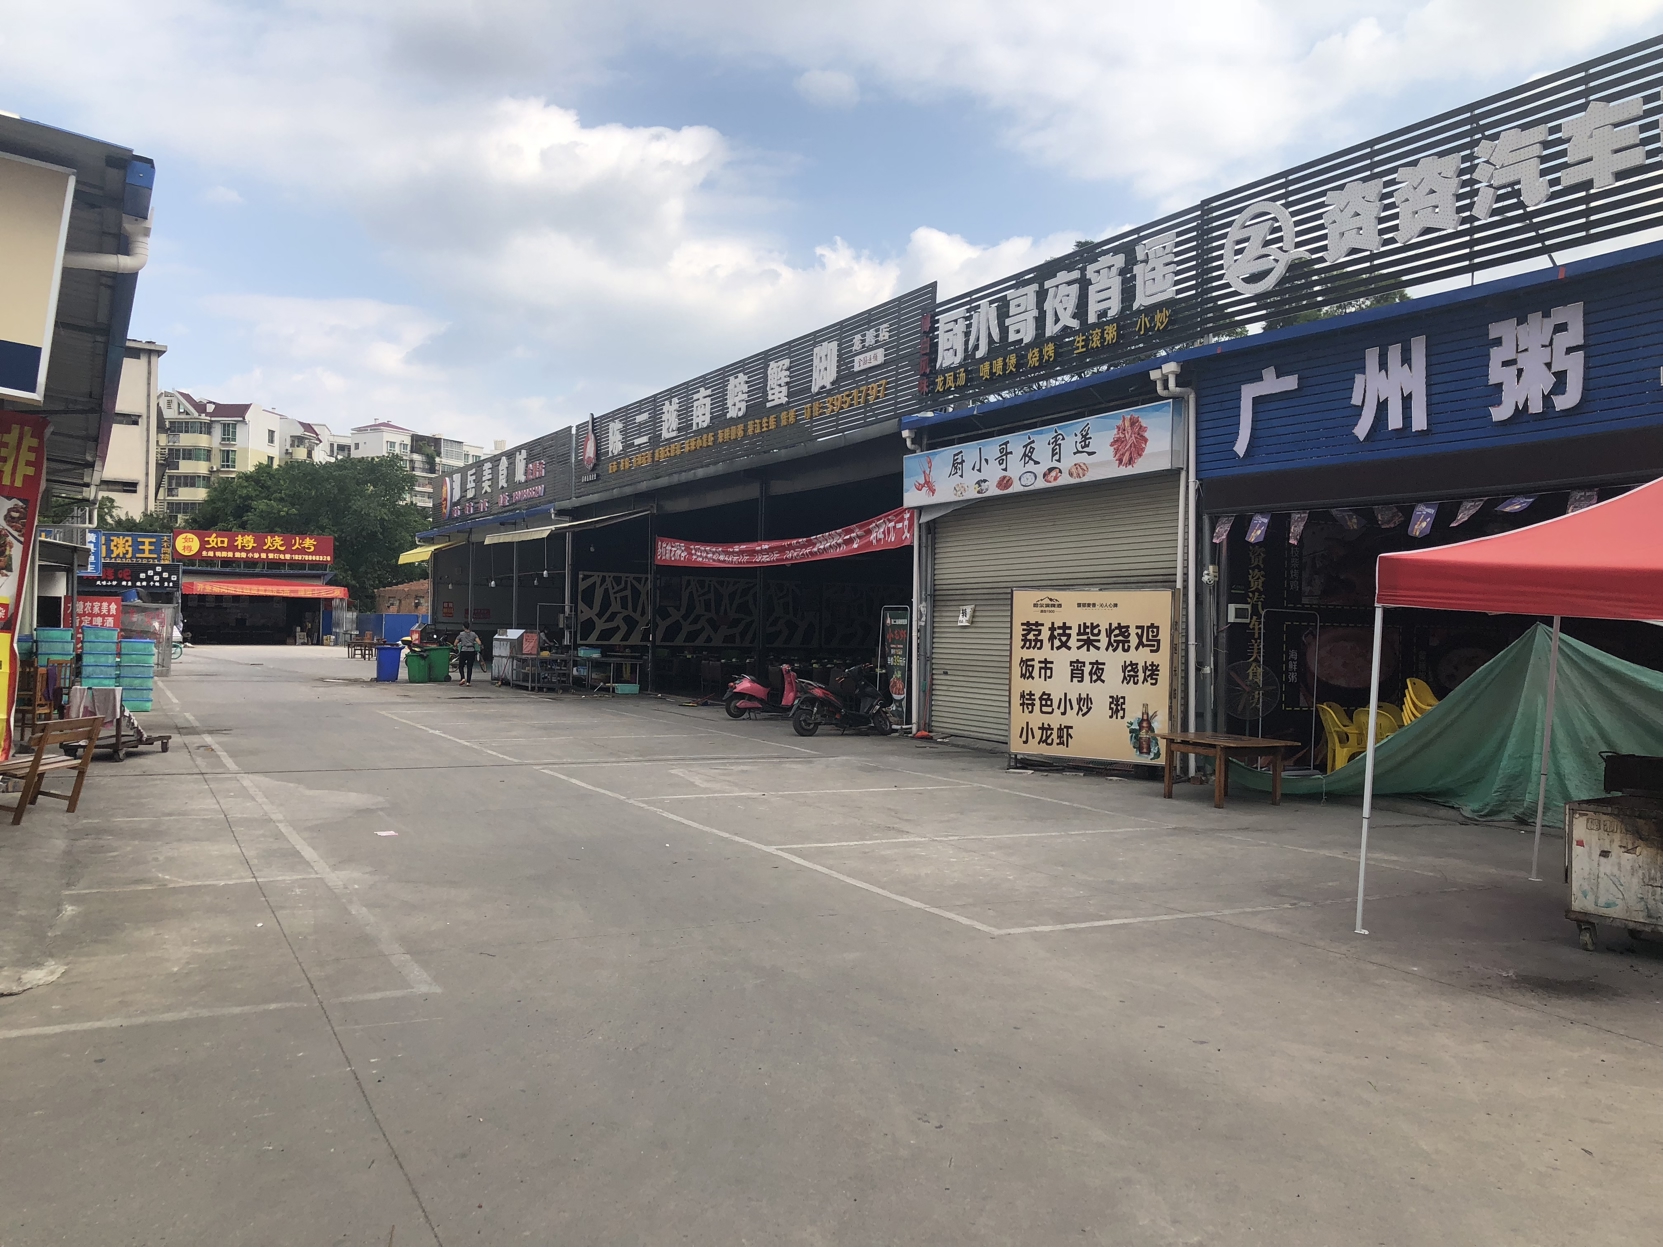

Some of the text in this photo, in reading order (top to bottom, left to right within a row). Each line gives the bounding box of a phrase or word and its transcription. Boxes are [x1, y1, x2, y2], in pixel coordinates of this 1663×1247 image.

[1323, 97, 1663, 263] 资资汽车
[936, 232, 1177, 371] 厨小哥夜宵遥
[935, 374, 966, 393] 龙凤汤
[1027, 343, 1055, 368] 烧烤
[1074, 325, 1118, 354] 生滚粥
[1136, 308, 1172, 335] 小炒
[1233, 302, 1663, 459] 广州粥
[948, 422, 1097, 479] 厨小哥夜宵遥
[205, 533, 317, 552] 如樽烧烤
[1289, 546, 1300, 592] 枝柴烤鸡
[1020, 621, 1161, 653] 荔枝柴烧鸡
[1019, 657, 1160, 686] 饭市 宵夜 烧烤
[1288, 649, 1299, 683] 海鲜粥
[1019, 690, 1126, 720] 特色小炒 粥
[1019, 721, 1074, 748] 小龙虾
